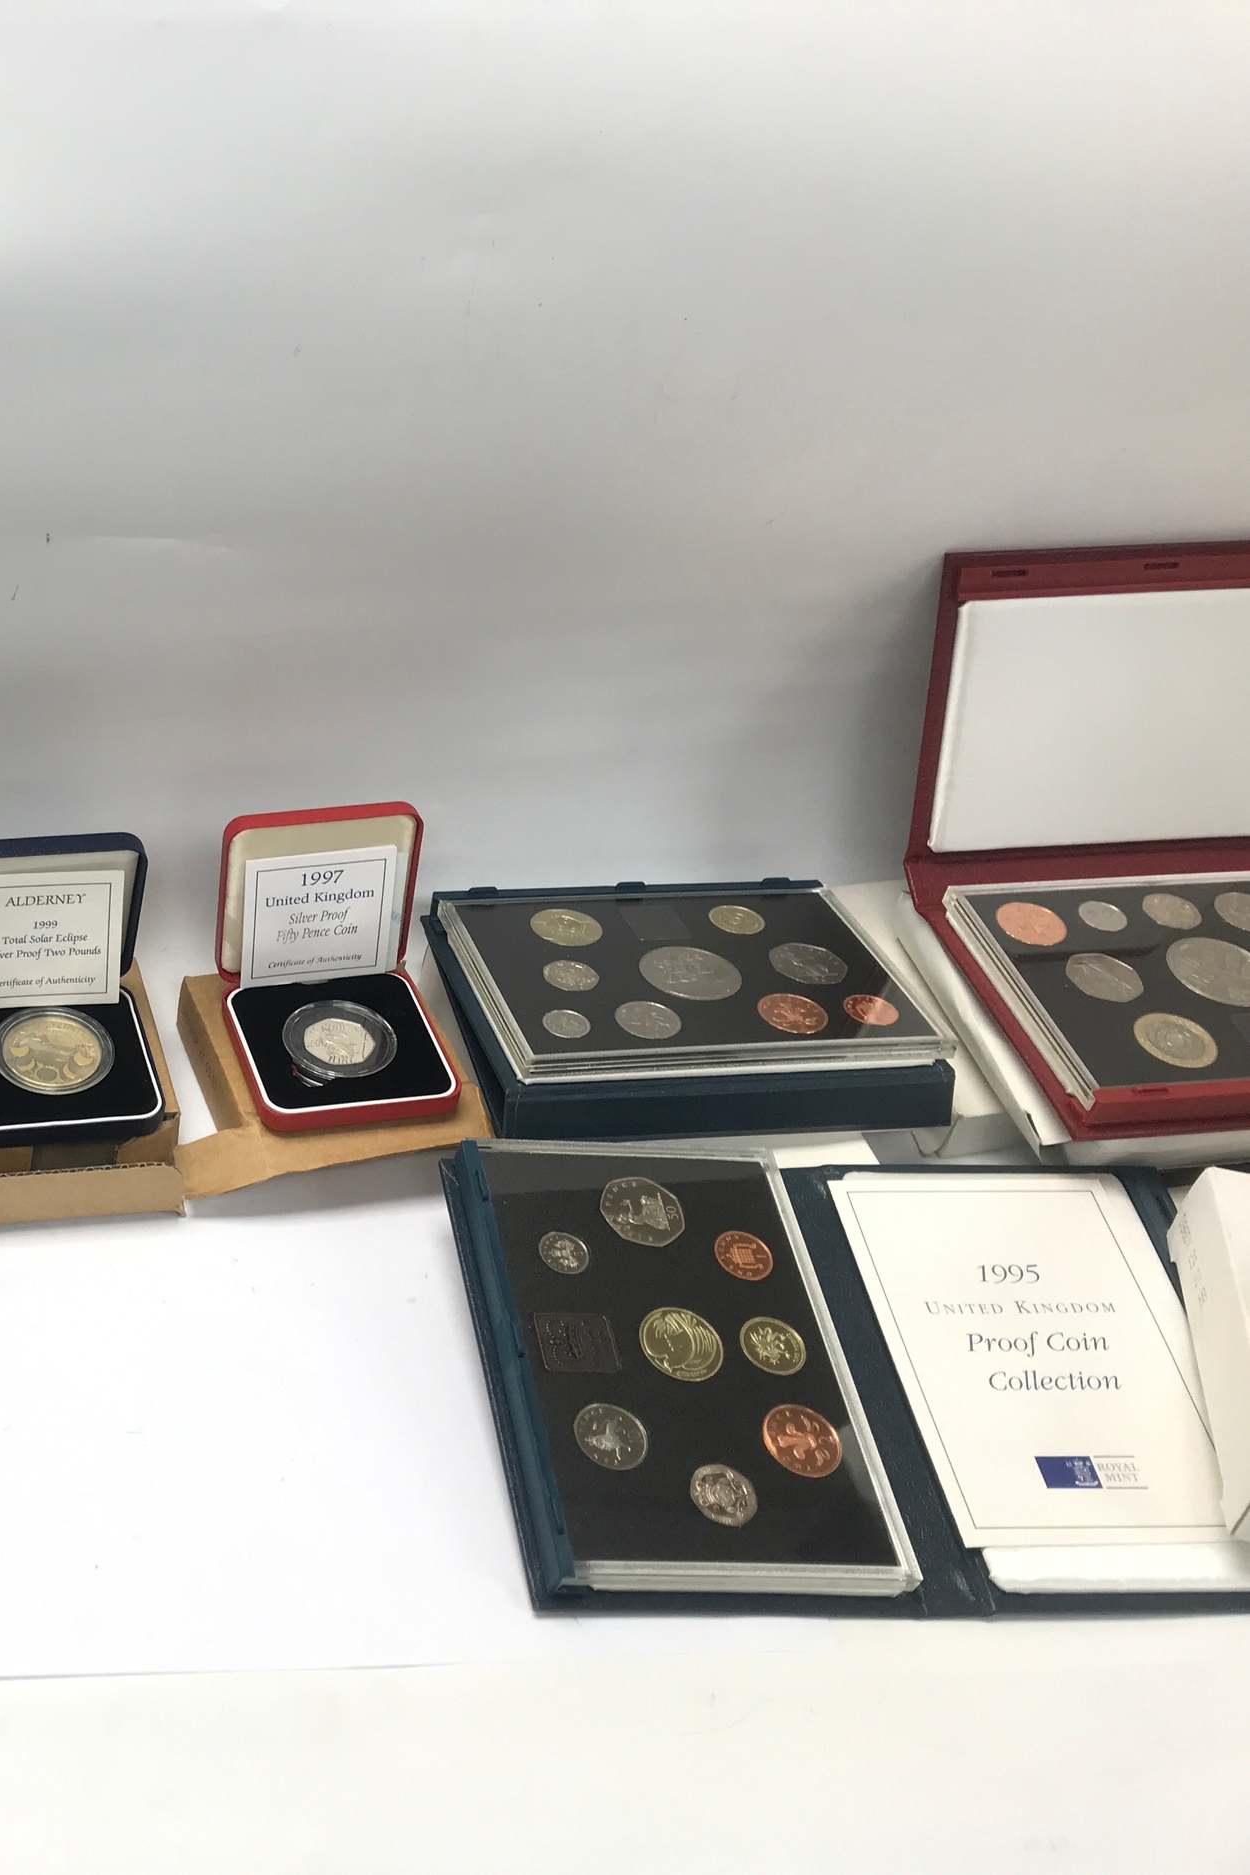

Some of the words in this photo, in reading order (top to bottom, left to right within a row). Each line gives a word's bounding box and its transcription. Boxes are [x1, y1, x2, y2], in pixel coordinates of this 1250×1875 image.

[301, 869, 344, 886] 1997
[5, 893, 86, 907] ALDERNEY
[265, 893, 309, 908] United
[314, 888, 374, 904] Kingdom
[289, 912, 318, 925] Silver
[320, 907, 351, 923] Proof
[33, 920, 58, 929] 1999
[2, 935, 27, 945] Total
[29, 934, 53, 943] Solar
[55, 932, 88, 944] Eclipse
[276, 928, 299, 944] Fifty
[302, 928, 330, 939] Pence
[333, 924, 358, 936] Coin
[16, 947, 42, 960] Proof
[44, 948, 66, 957] Two
[68, 946, 101, 956] Pounds
[268, 958, 305, 969] Certificate
[306, 957, 315, 965] of
[316, 953, 362, 964] Authenticity
[35, 977, 45, 988] of
[45, 975, 96, 986] Authenticity
[977, 1263, 1040, 1285] 1995
[924, 1300, 1004, 1315] UNITED
[1014, 1300, 1117, 1315] KINGDOM
[966, 1331, 1039, 1358] Proof
[1046, 1331, 1110, 1352] Coin
[988, 1369, 1122, 1392] Collection
[1097, 1462, 1140, 1472] ROYAL
[1104, 1473, 1139, 1483] MINT
